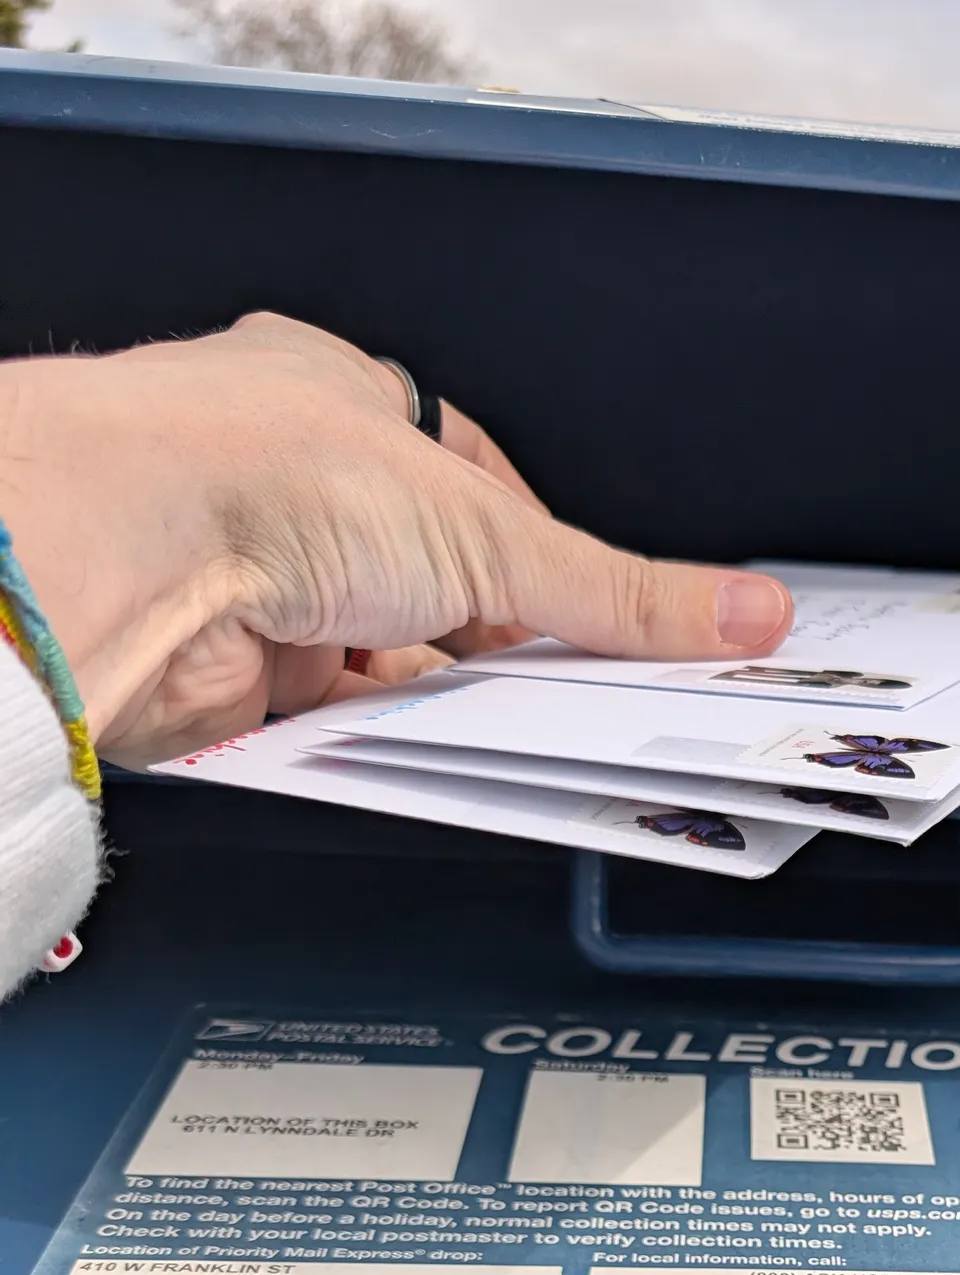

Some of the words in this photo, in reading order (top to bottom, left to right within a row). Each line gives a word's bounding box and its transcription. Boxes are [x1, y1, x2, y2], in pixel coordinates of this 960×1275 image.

[277, 1022, 365, 1036] UNITED
[267, 1032, 346, 1045] POSTAL
[244, 1062, 274, 1070] PM
[532, 1057, 631, 1073] Saturday
[749, 1065, 802, 1078] Scan
[809, 1067, 855, 1080] here
[641, 1073, 669, 1083] PM
[171, 1114, 285, 1126] LOCATION
[292, 1117, 312, 1127] OF
[322, 1118, 368, 1129] THIS
[375, 1120, 419, 1130] BOX
[183, 1125, 216, 1134] 611
[224, 1126, 239, 1134] N
[244, 1126, 357, 1137] LYNNDALE
[365, 1128, 395, 1138] DR
[126, 1176, 153, 1189] To
[159, 1177, 208, 1190] find
[214, 1178, 254, 1191] the
[260, 1180, 354, 1193] nearest
[361, 1181, 418, 1194] Post
[517, 1184, 614, 1199] location
[621, 1187, 672, 1200] with
[679, 1188, 717, 1200] the
[723, 1189, 823, 1203] address,
[830, 1191, 895, 1205] hours
[902, 1193, 924, 1205] of
[115, 1192, 229, 1207] distance,
[235, 1194, 297, 1207] scan
[302, 1195, 345, 1208] the
[351, 1195, 391, 1209] QR
[399, 1196, 470, 1210] Code.
[478, 1198, 506, 1211] To
[512, 1200, 589, 1213] report
[593, 1200, 633, 1213] QR
[640, 1201, 704, 1214] Code
[711, 1203, 794, 1217] issues,
[799, 1207, 831, 1219] go
[837, 1207, 861, 1218] to
[106, 1208, 143, 1221] On
[151, 1209, 192, 1222] the
[199, 1211, 245, 1225] day
[250, 1211, 333, 1225] before
[338, 1213, 355, 1225] a
[362, 1213, 458, 1229] holiday,
[465, 1215, 553, 1228] normal
[559, 1217, 680, 1231] collection
[687, 1219, 754, 1232] times
[761, 1222, 811, 1235] may
[817, 1222, 857, 1235] not
[863, 1223, 932, 1238] apply.
[97, 1224, 181, 1238] Check
[187, 1226, 242, 1239] with
[248, 1229, 308, 1241] your
[312, 1228, 376, 1241] local
[381, 1230, 529, 1244] postmaster
[535, 1232, 560, 1245] to
[566, 1233, 636, 1248] verify
[642, 1235, 763, 1249] collection
[769, 1236, 843, 1250] times.
[81, 1243, 173, 1256] Location
[178, 1245, 199, 1256] of
[204, 1246, 279, 1259] Priority
[284, 1247, 328, 1259] Mail
[430, 1250, 484, 1263] drop:
[592, 1251, 627, 1264] For
[632, 1252, 679, 1264] local
[685, 1253, 803, 1267] information,
[808, 1255, 848, 1267] call:
[80, 1261, 117, 1272] 410
[124, 1262, 146, 1273] W
[150, 1262, 261, 1275] FRANKLIN
[267, 1264, 297, 1275] ST
